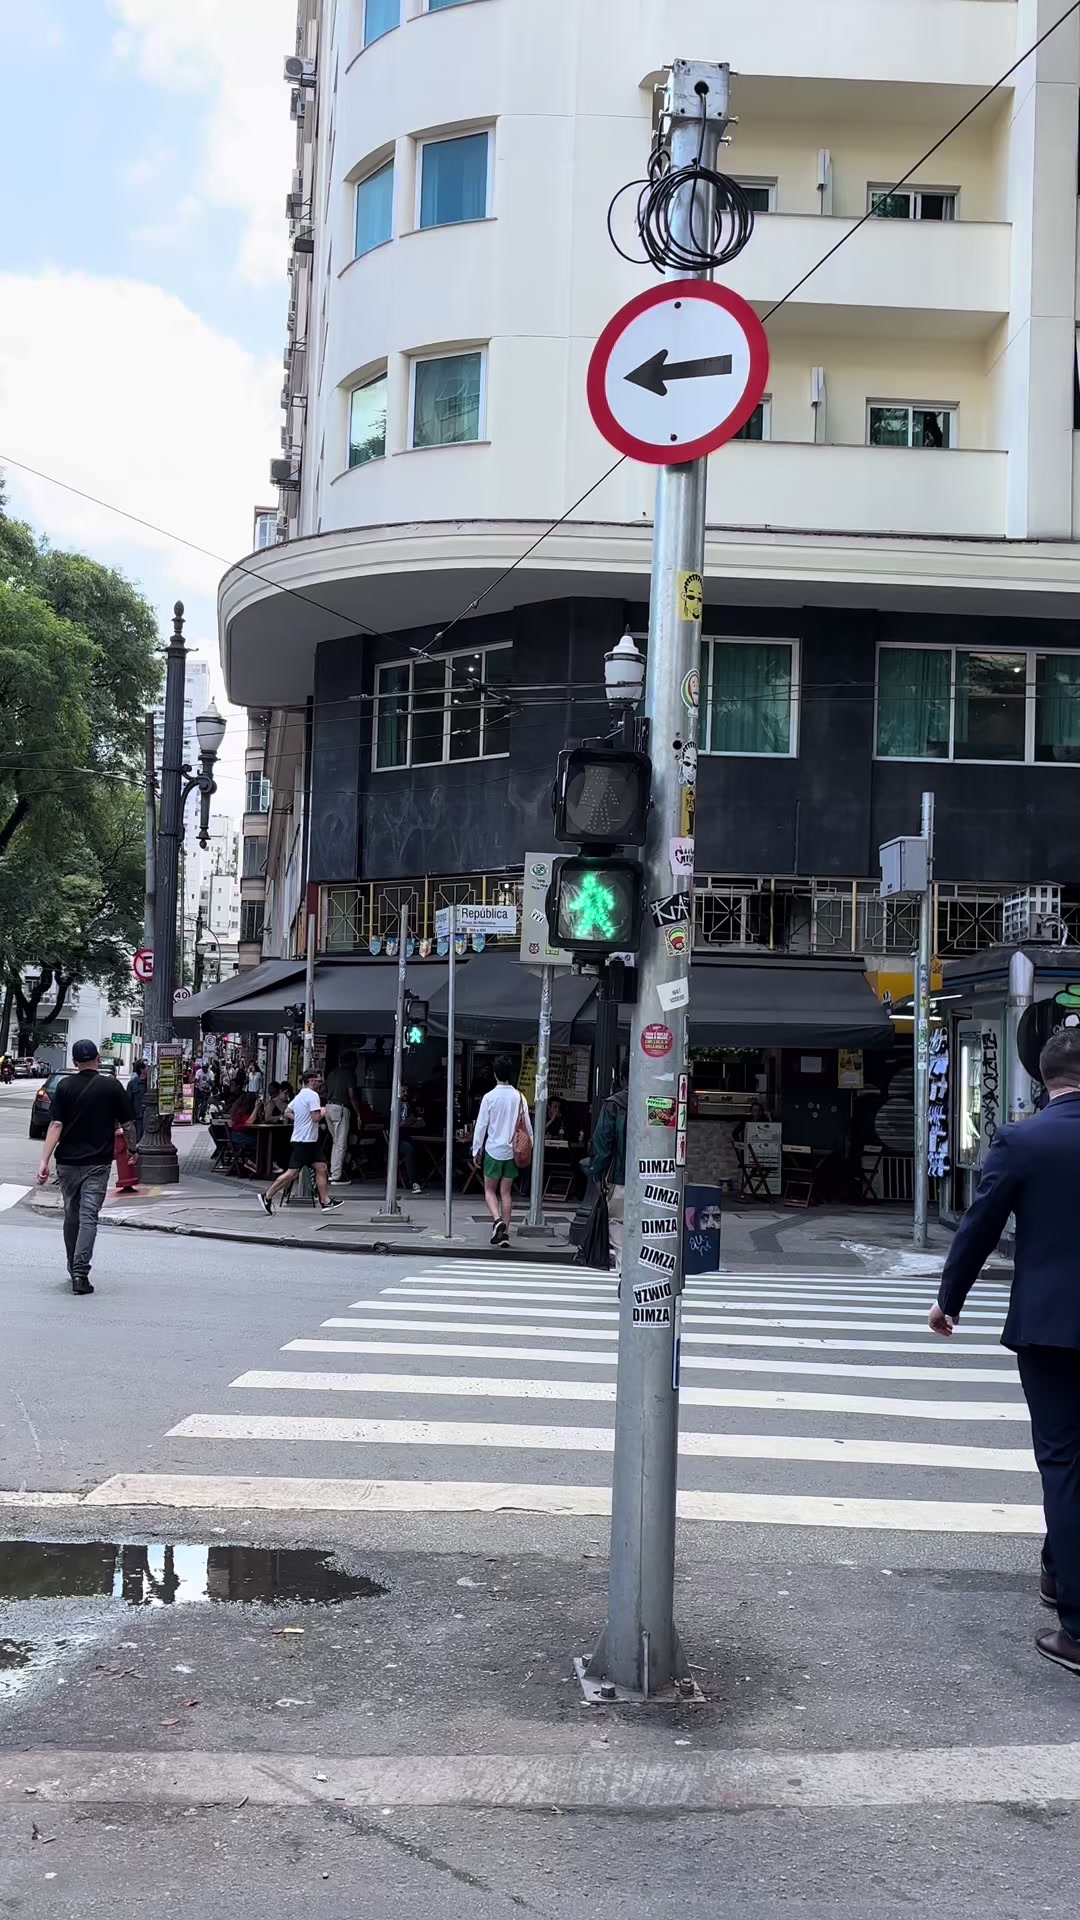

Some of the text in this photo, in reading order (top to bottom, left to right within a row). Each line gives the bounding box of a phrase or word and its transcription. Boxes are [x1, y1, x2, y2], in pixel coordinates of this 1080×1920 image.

[461, 908, 508, 920] República
[143, 956, 152, 972] E
[174, 991, 188, 999] 40
[639, 1160, 675, 1173] DIMZA
[644, 1185, 679, 1205] DIMZA
[641, 1219, 677, 1233] DIMZA
[640, 1246, 675, 1270] DIMZA
[634, 1283, 672, 1304] DIMZA
[633, 1308, 669, 1322] DIMZA
